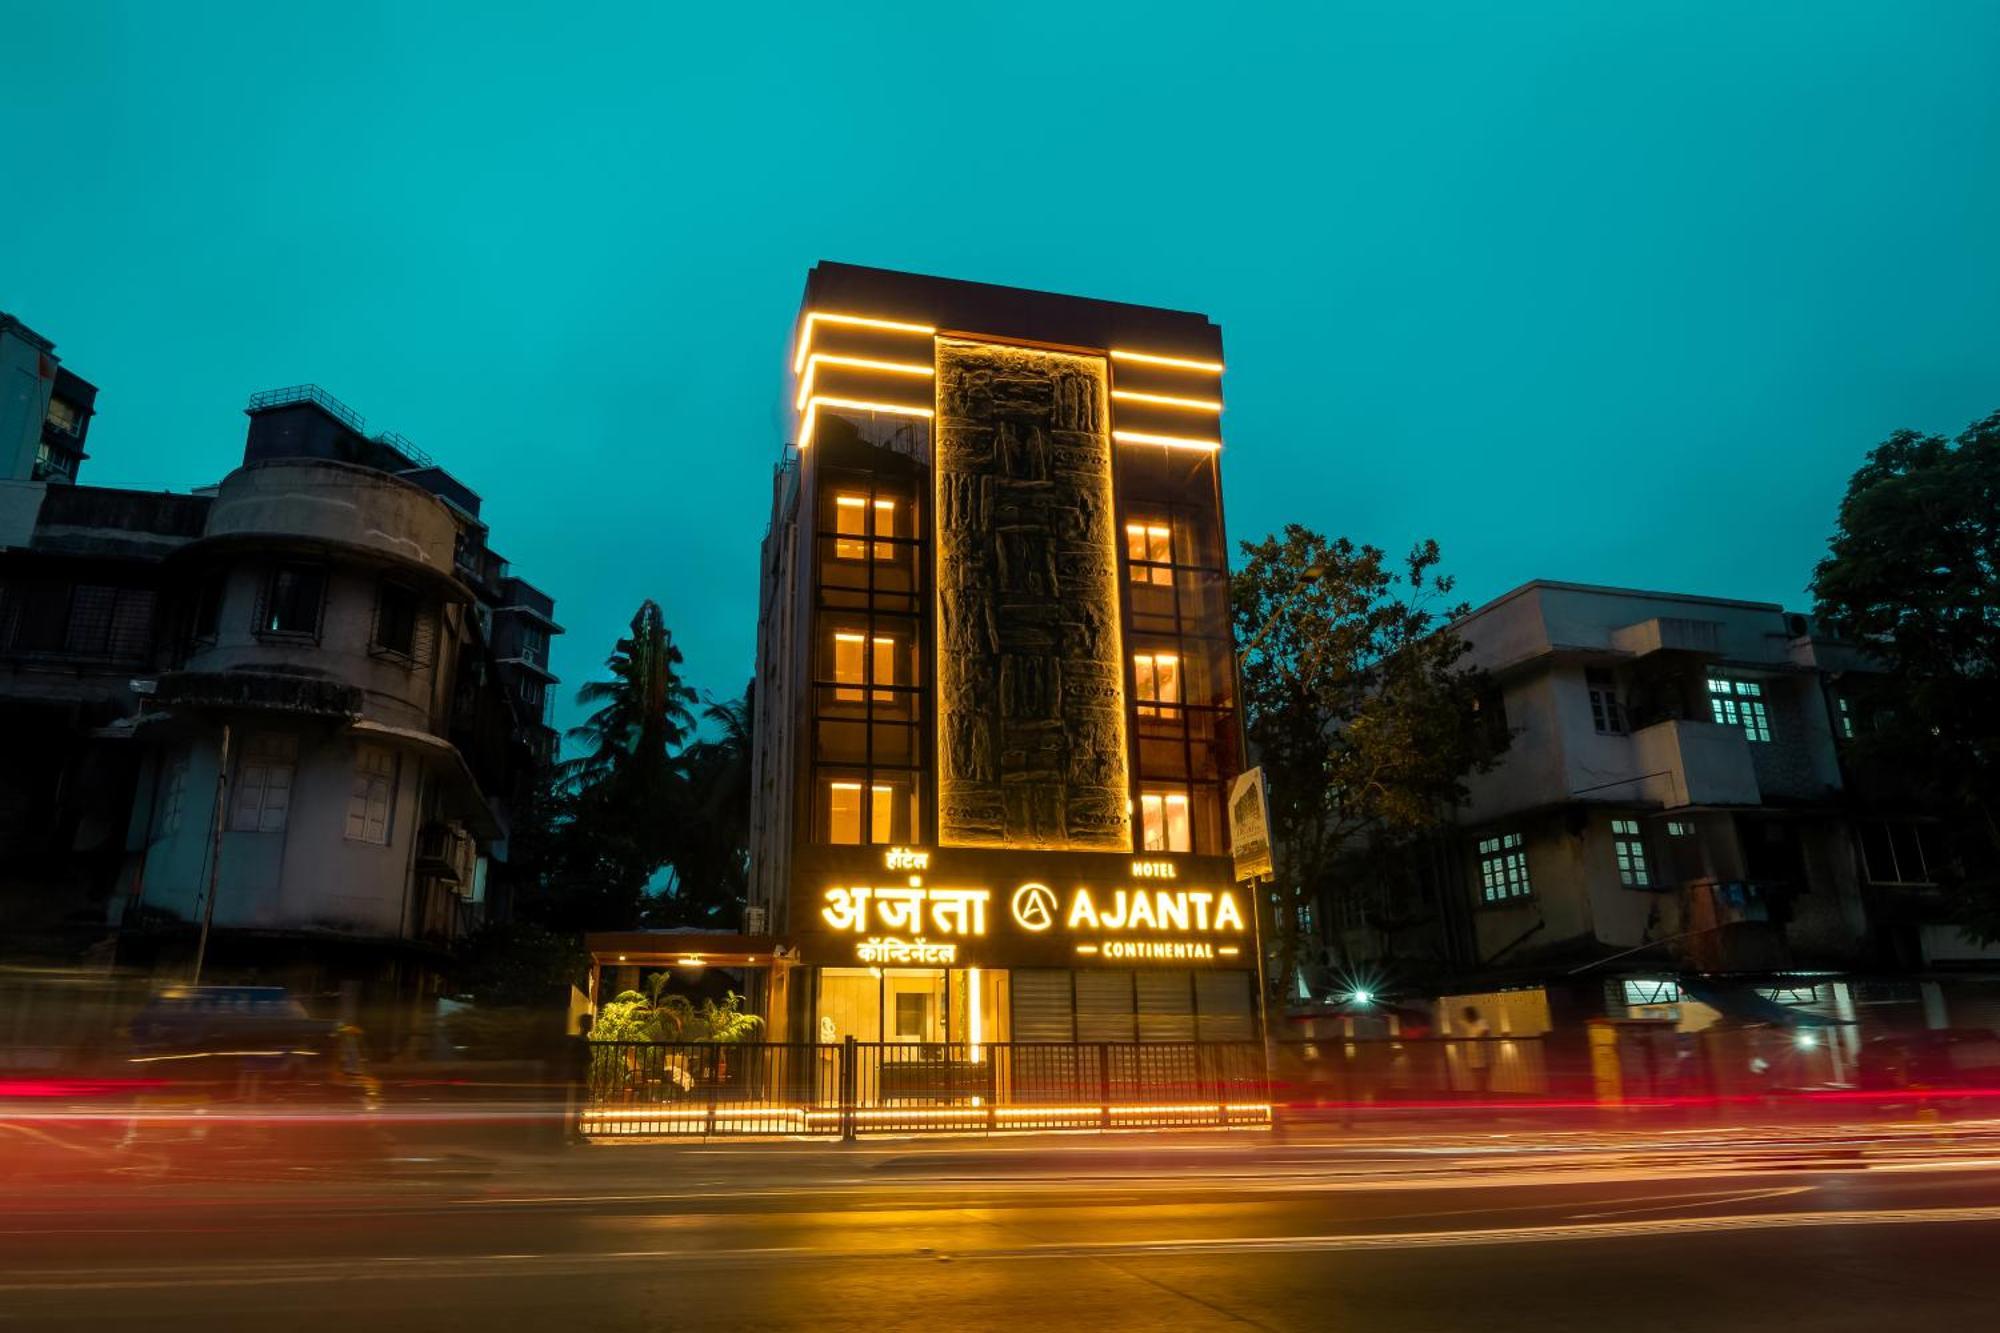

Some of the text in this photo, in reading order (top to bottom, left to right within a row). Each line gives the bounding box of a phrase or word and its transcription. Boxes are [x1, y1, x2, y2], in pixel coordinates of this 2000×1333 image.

[885, 846, 929, 870] हॉटेल
[1131, 861, 1176, 879] HOTEL
[821, 875, 990, 935] अजंता
[1067, 887, 1244, 931] AJANTA
[1102, 941, 1214, 959] CONTINENTAL
